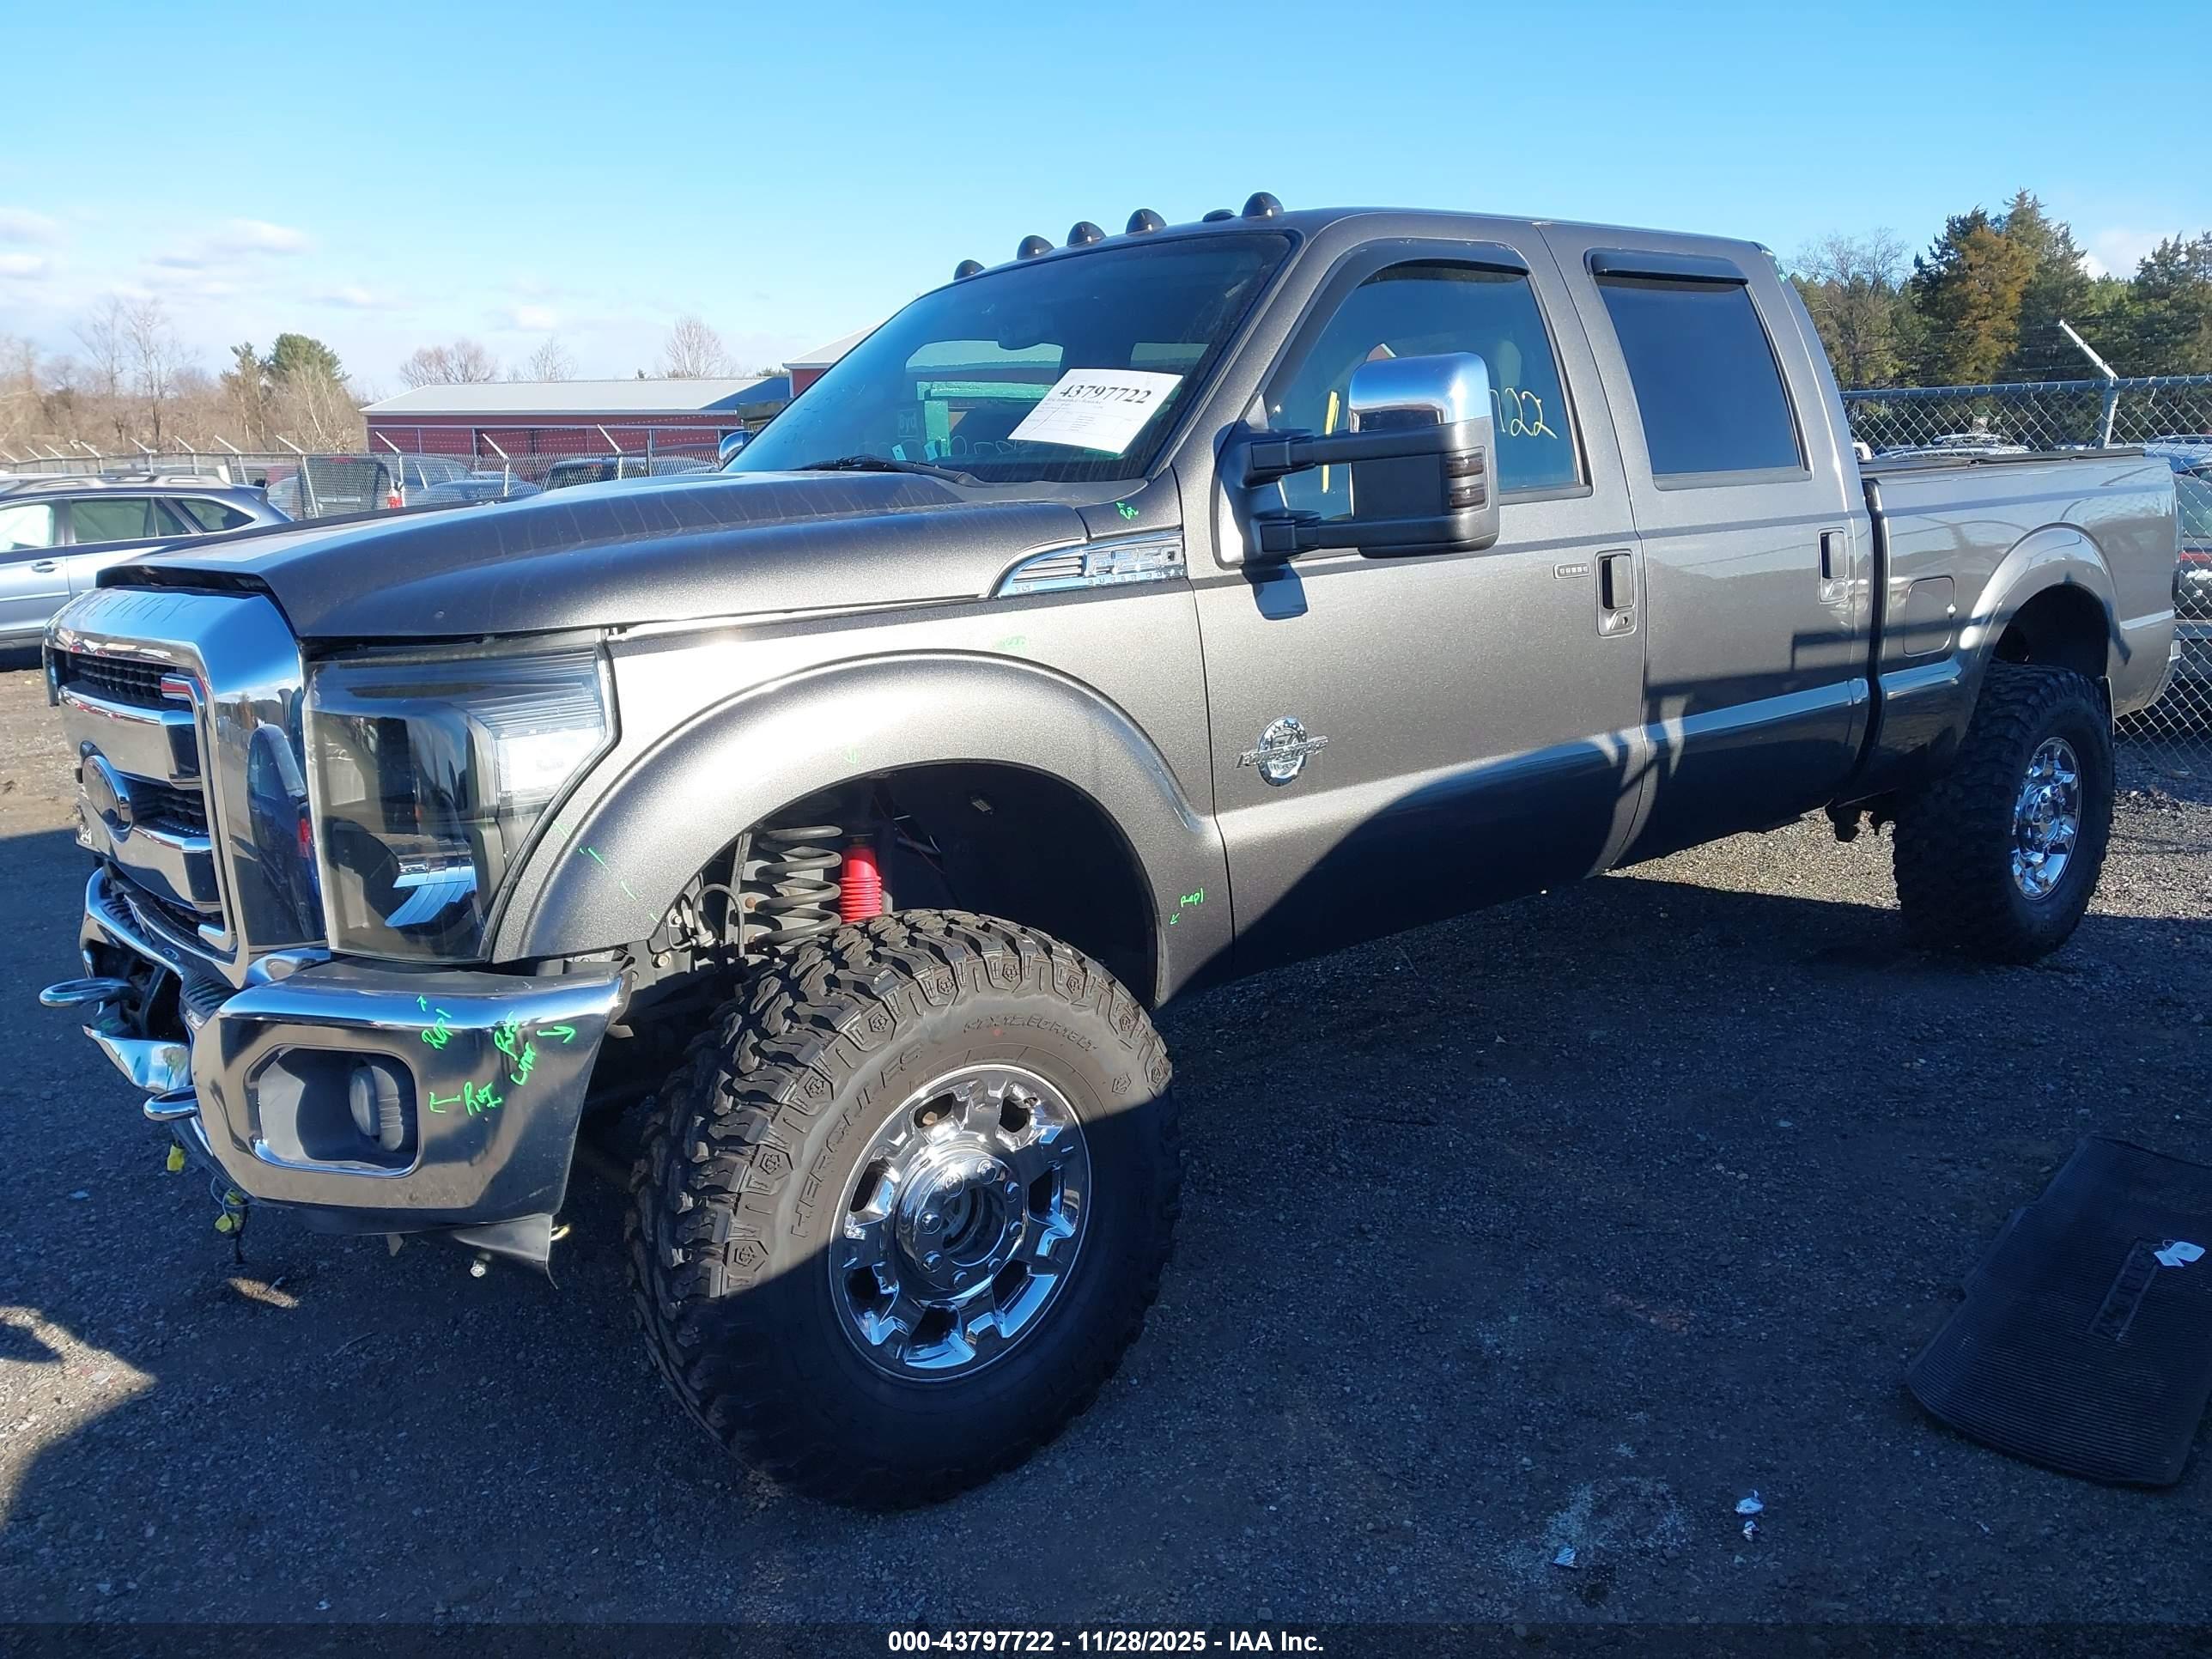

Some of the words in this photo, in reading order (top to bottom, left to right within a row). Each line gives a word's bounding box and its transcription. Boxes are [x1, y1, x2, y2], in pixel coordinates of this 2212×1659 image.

[1059, 384, 1152, 404] 43797722
[1086, 575, 1139, 586] SUPER
[790, 1042, 923, 1239] HERCULES
